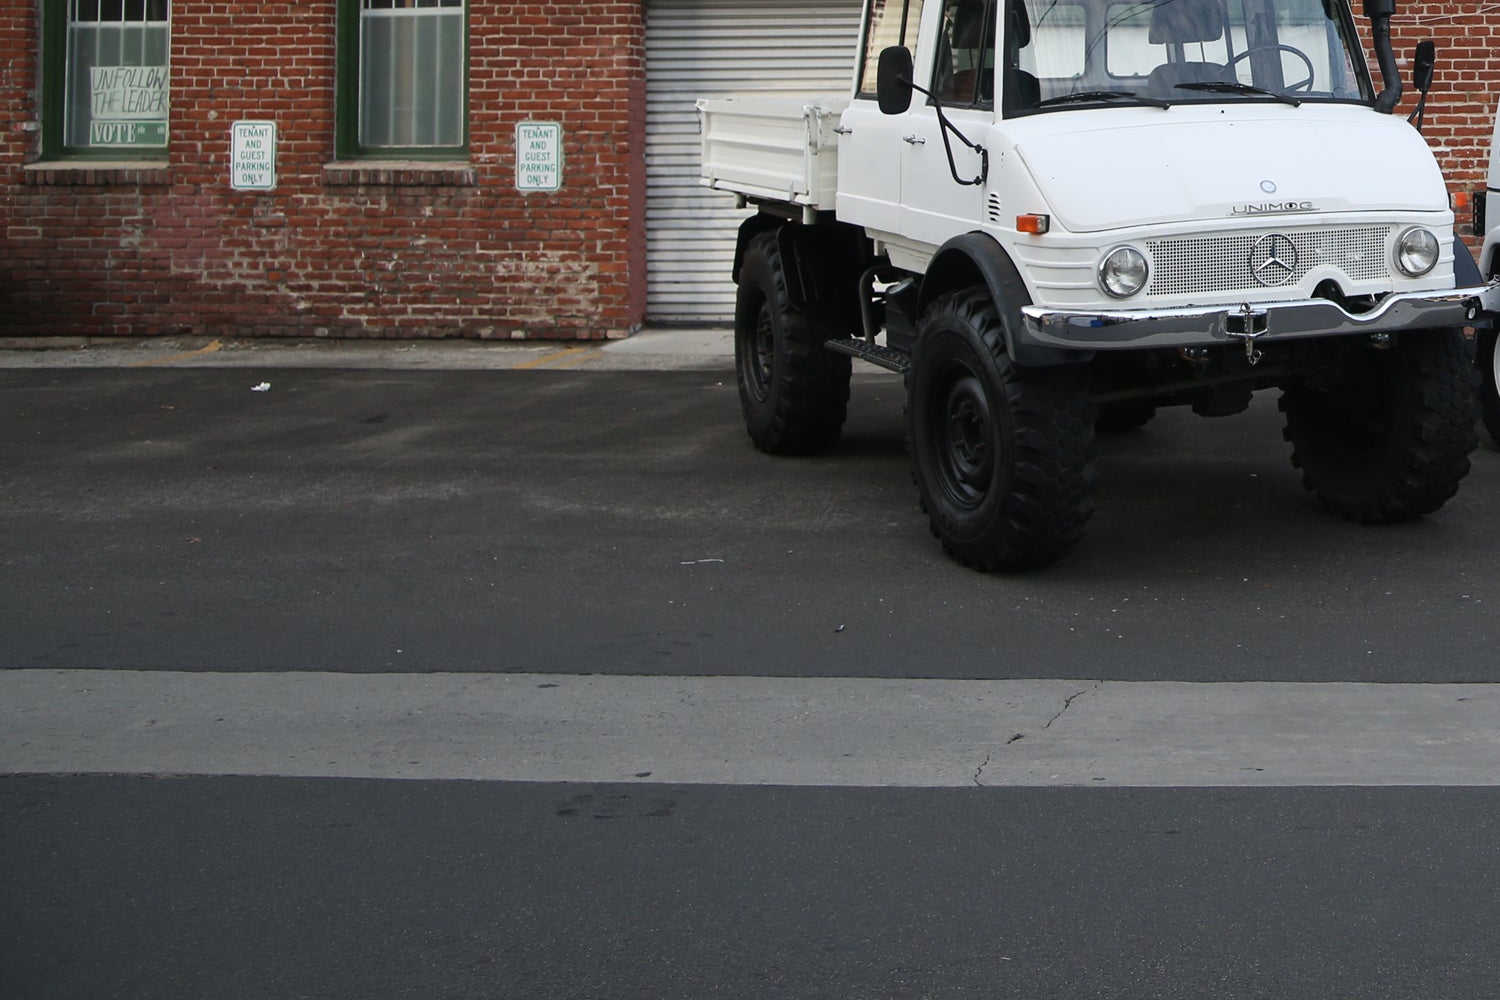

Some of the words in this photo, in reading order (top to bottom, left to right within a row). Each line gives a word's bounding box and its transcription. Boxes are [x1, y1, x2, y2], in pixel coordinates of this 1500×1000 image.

[93, 67, 168, 91] UNFOLLOW
[93, 90, 122, 114] THE
[121, 88, 168, 113] LEADER
[94, 123, 136, 143] VOTE
[238, 128, 269, 138] TENANT
[522, 129, 554, 139] TENANT
[245, 139, 262, 149] AND
[530, 140, 547, 150] AND
[240, 150, 265, 160] GUEST
[525, 152, 551, 161] GUEST
[235, 162, 270, 171] PARKING
[520, 163, 556, 172] PARKING
[242, 173, 263, 182] ONLY
[526, 174, 549, 184] ONLY
[1232, 201, 1313, 214] UNIMOG
